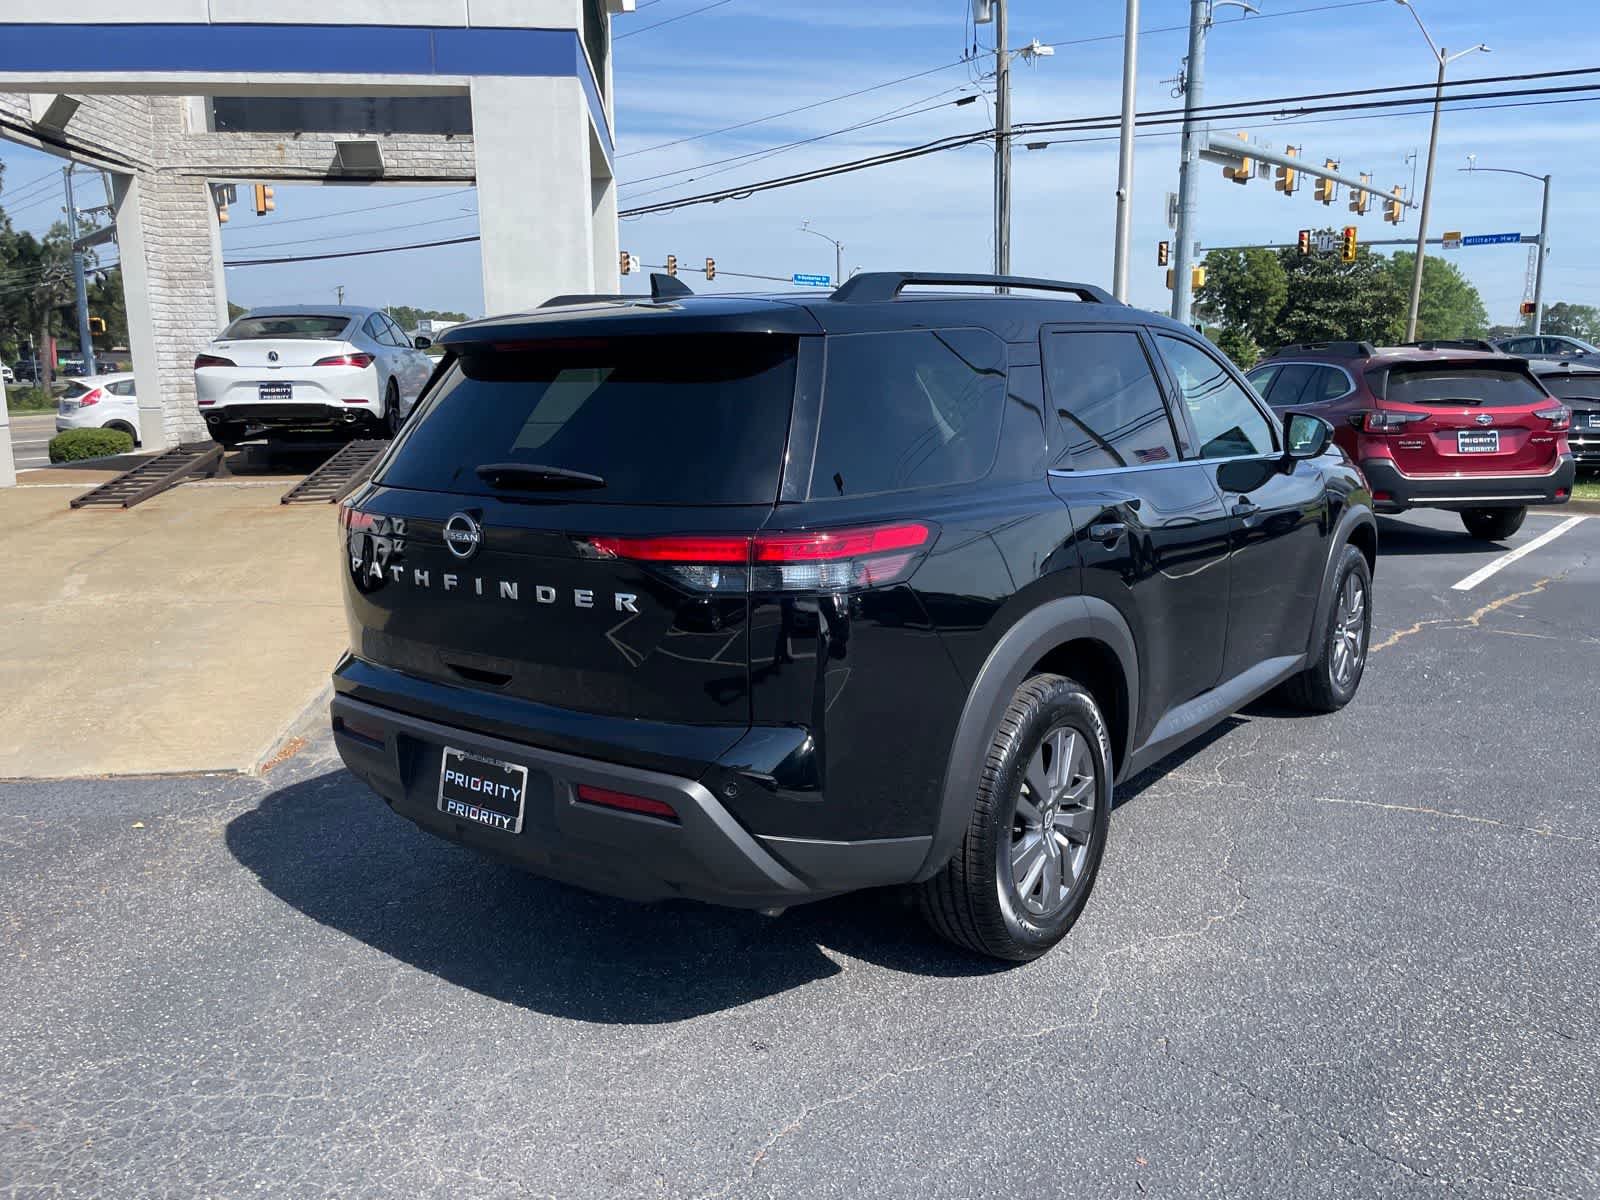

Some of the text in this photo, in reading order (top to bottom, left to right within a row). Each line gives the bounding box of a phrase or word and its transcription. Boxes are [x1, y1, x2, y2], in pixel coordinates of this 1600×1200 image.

[1465, 236, 1497, 244] Military
[352, 557, 640, 613] PATHFINDER
[445, 769, 521, 802] PRIORITY
[447, 801, 511, 829] PRIORITY
